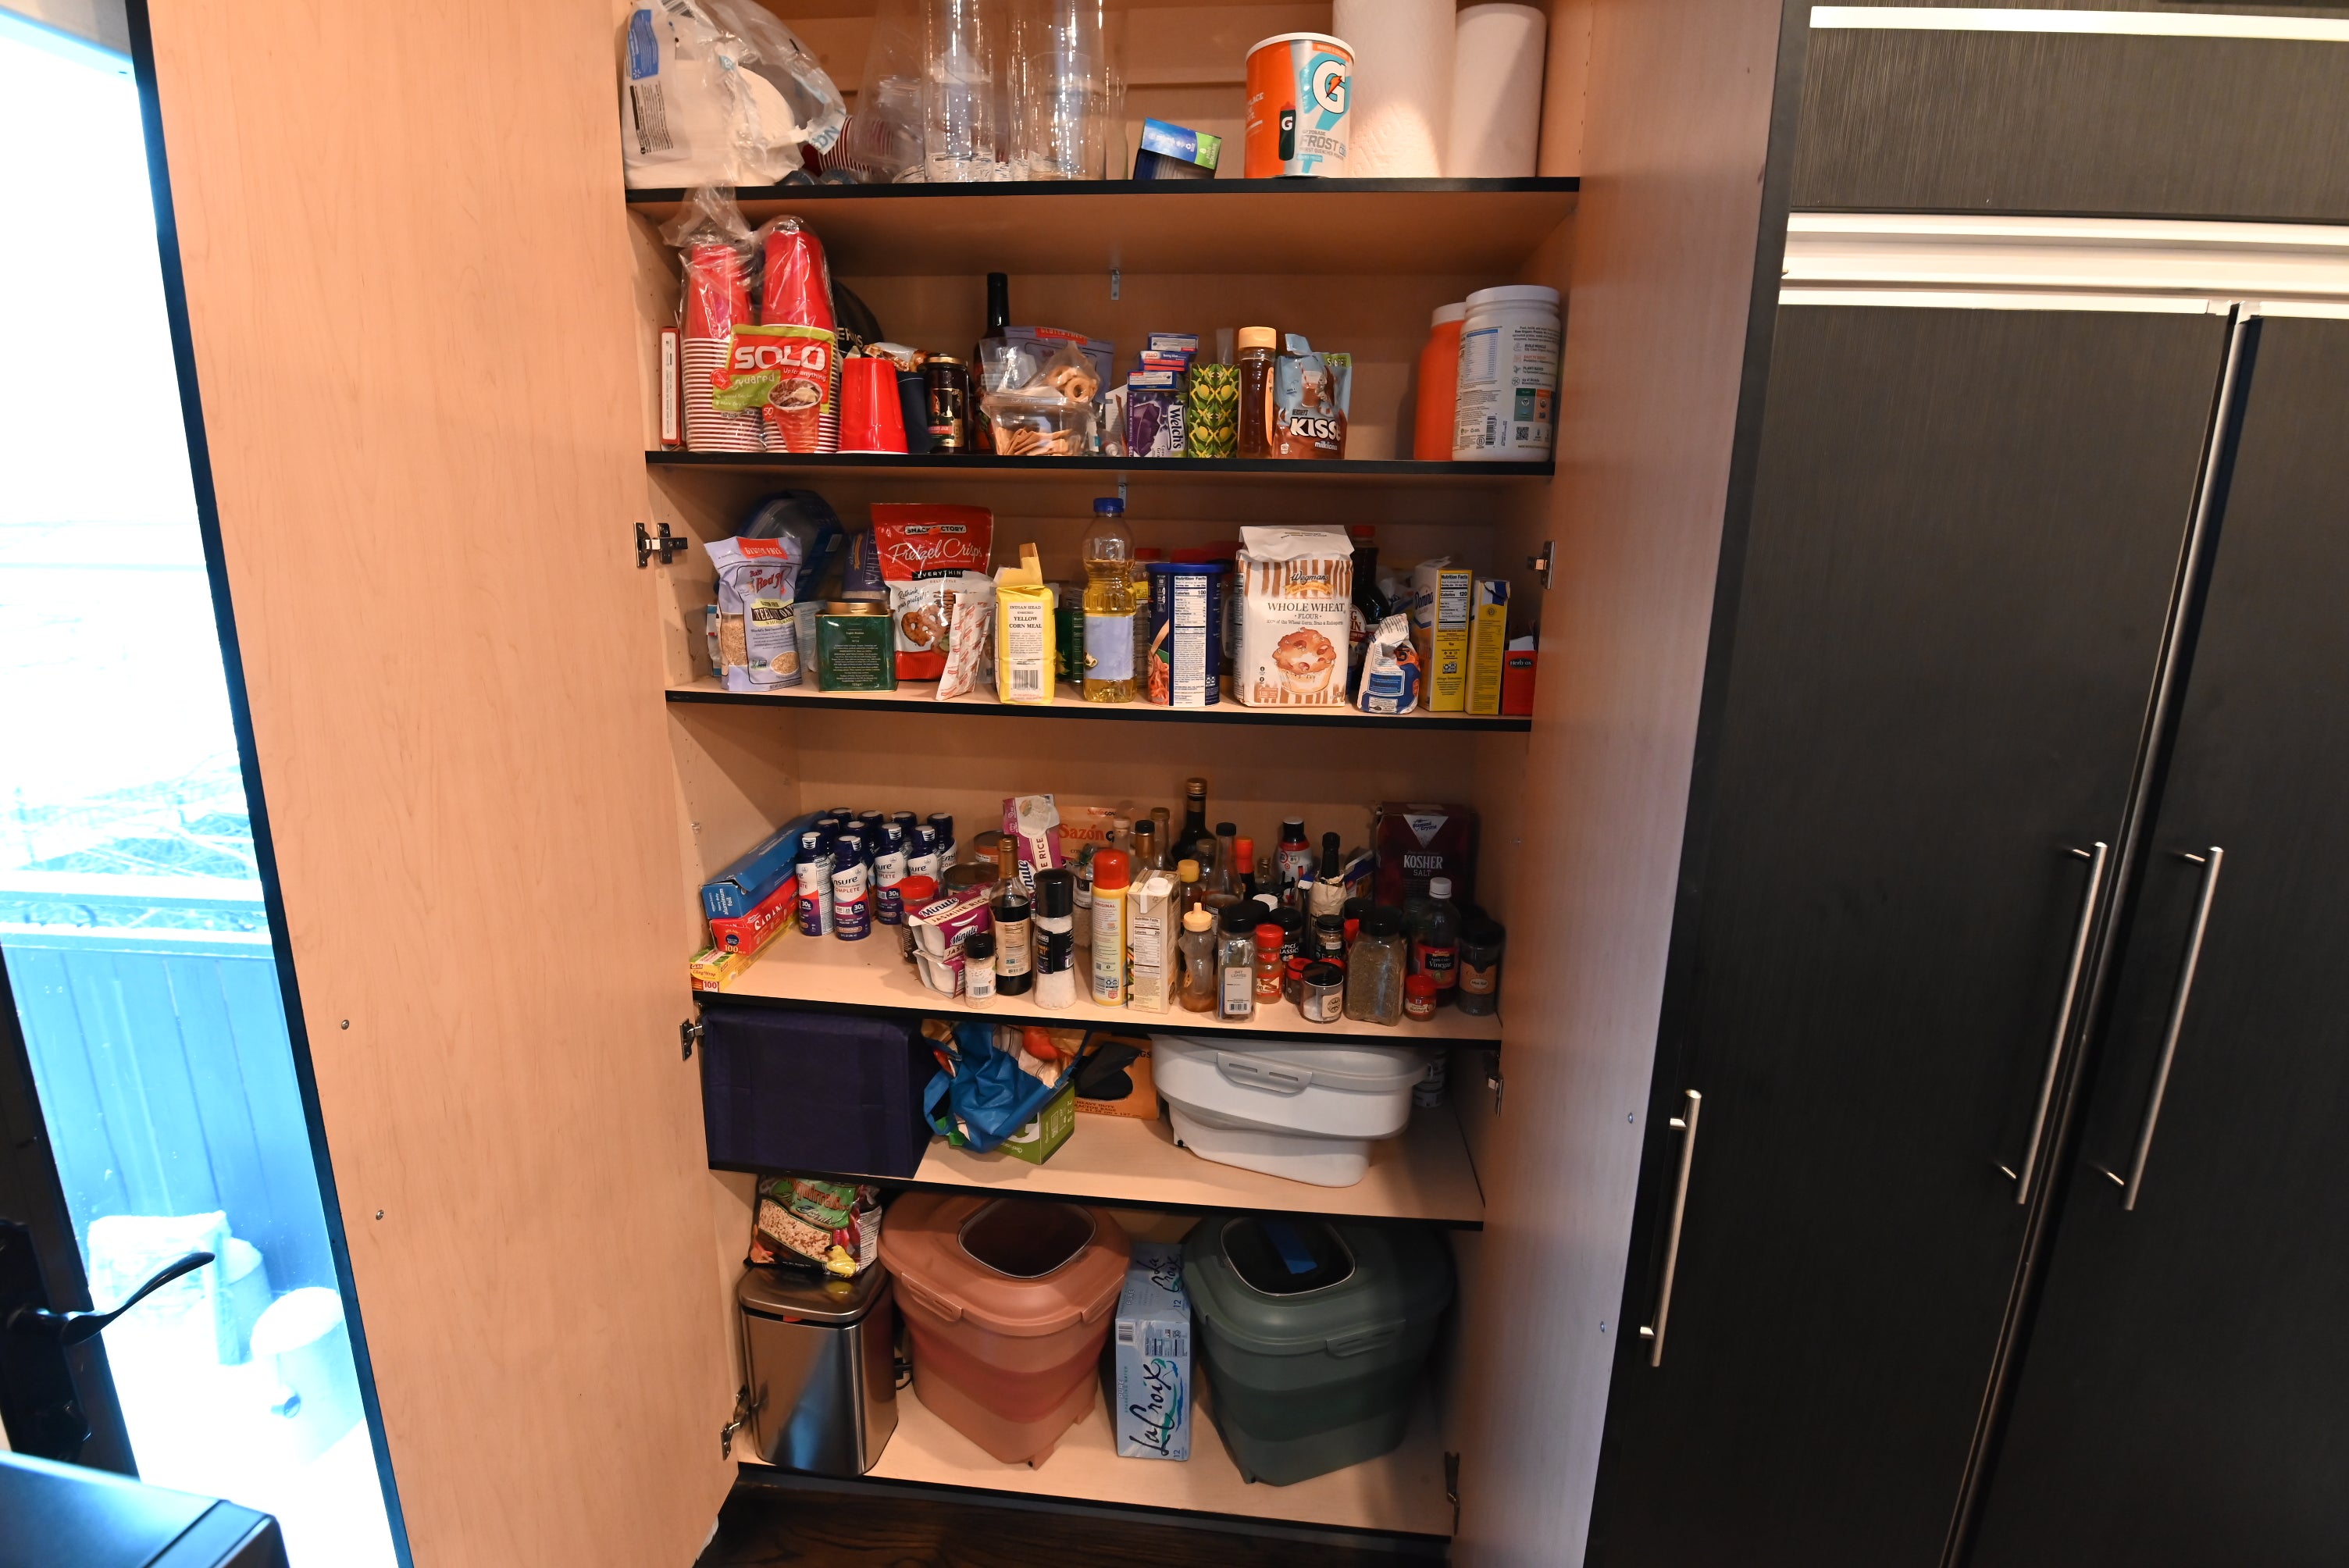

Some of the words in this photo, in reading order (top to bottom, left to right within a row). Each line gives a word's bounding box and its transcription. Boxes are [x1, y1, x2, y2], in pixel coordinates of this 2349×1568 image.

[1312, 60, 1346, 114] G
[1281, 116, 1292, 130] G
[1299, 134, 1339, 151] FROST
[734, 345, 826, 371] SOLO
[800, 370, 826, 383] anything
[764, 407, 774, 416] 50
[1169, 407, 1184, 450] Welch's
[1290, 417, 1341, 441] KISS
[888, 539, 943, 569] Pretzel
[943, 538, 982, 562] Crisps
[918, 570, 962, 579] EVERYTHIN
[1290, 571, 1328, 585] Wegmans
[757, 574, 775, 593] Red
[898, 587, 919, 600] Rethink
[754, 608, 772, 620] TEEL
[779, 604, 794, 617] OAT
[1267, 602, 1309, 611] WHOLE
[1311, 603, 1345, 612] WHEAT
[1059, 824, 1104, 841] Sazón
[1036, 837, 1047, 859] RICE
[1403, 854, 1443, 869] KOSHER
[832, 875, 859, 886] nsure
[719, 888, 729, 915] aluminum
[920, 897, 958, 917] Minute
[931, 905, 968, 923] JASMINE
[968, 898, 989, 907] RICE
[950, 926, 978, 945] Minute
[725, 944, 739, 953] 100
[1126, 1290, 1135, 1305] PURE
[1173, 1299, 1182, 1308] 12
[1173, 1449, 1181, 1458] 12
